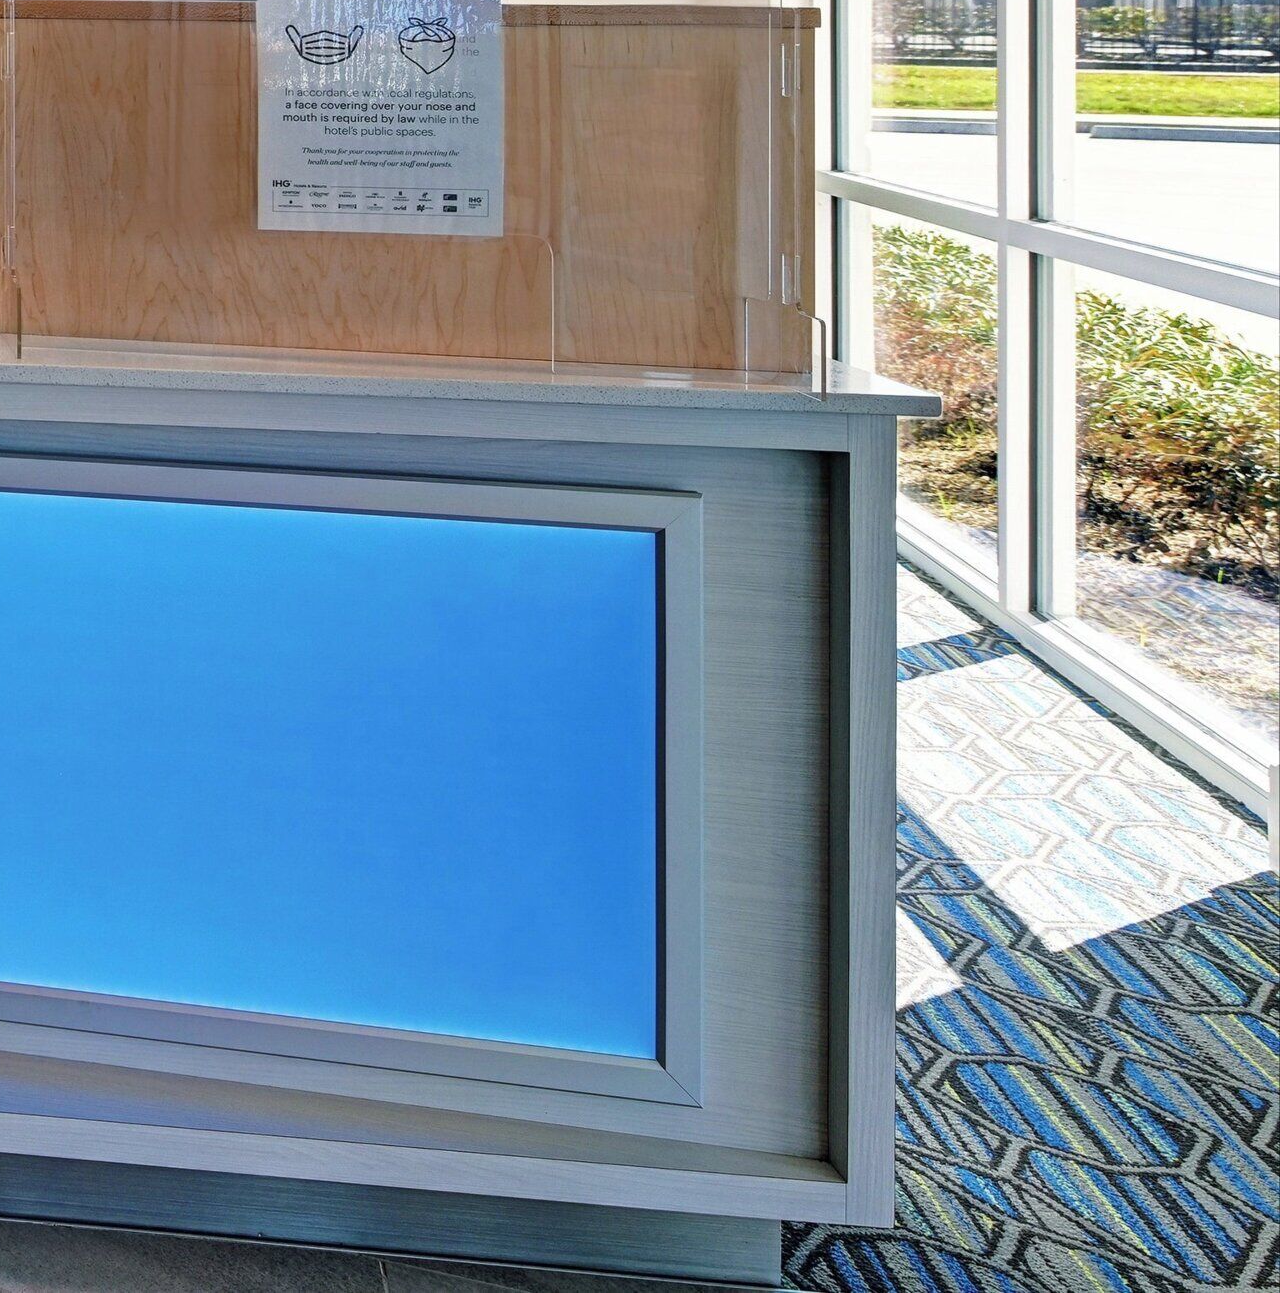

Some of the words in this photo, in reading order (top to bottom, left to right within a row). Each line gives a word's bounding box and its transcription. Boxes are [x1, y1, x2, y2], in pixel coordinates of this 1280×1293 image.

[297, 89, 358, 97] accordance
[388, 90, 411, 98] ocal
[295, 101, 317, 109] face
[321, 101, 367, 112] covering
[398, 104, 422, 112] your
[455, 103, 475, 111] and
[283, 113, 317, 121] mouth
[321, 114, 328, 122] is
[333, 114, 377, 125] required
[382, 115, 394, 125] by
[398, 115, 415, 123] law
[419, 115, 446, 123] while
[462, 116, 479, 124] the
[325, 126, 358, 135] hotel's
[361, 127, 391, 137] public
[396, 130, 435, 138] spaces.
